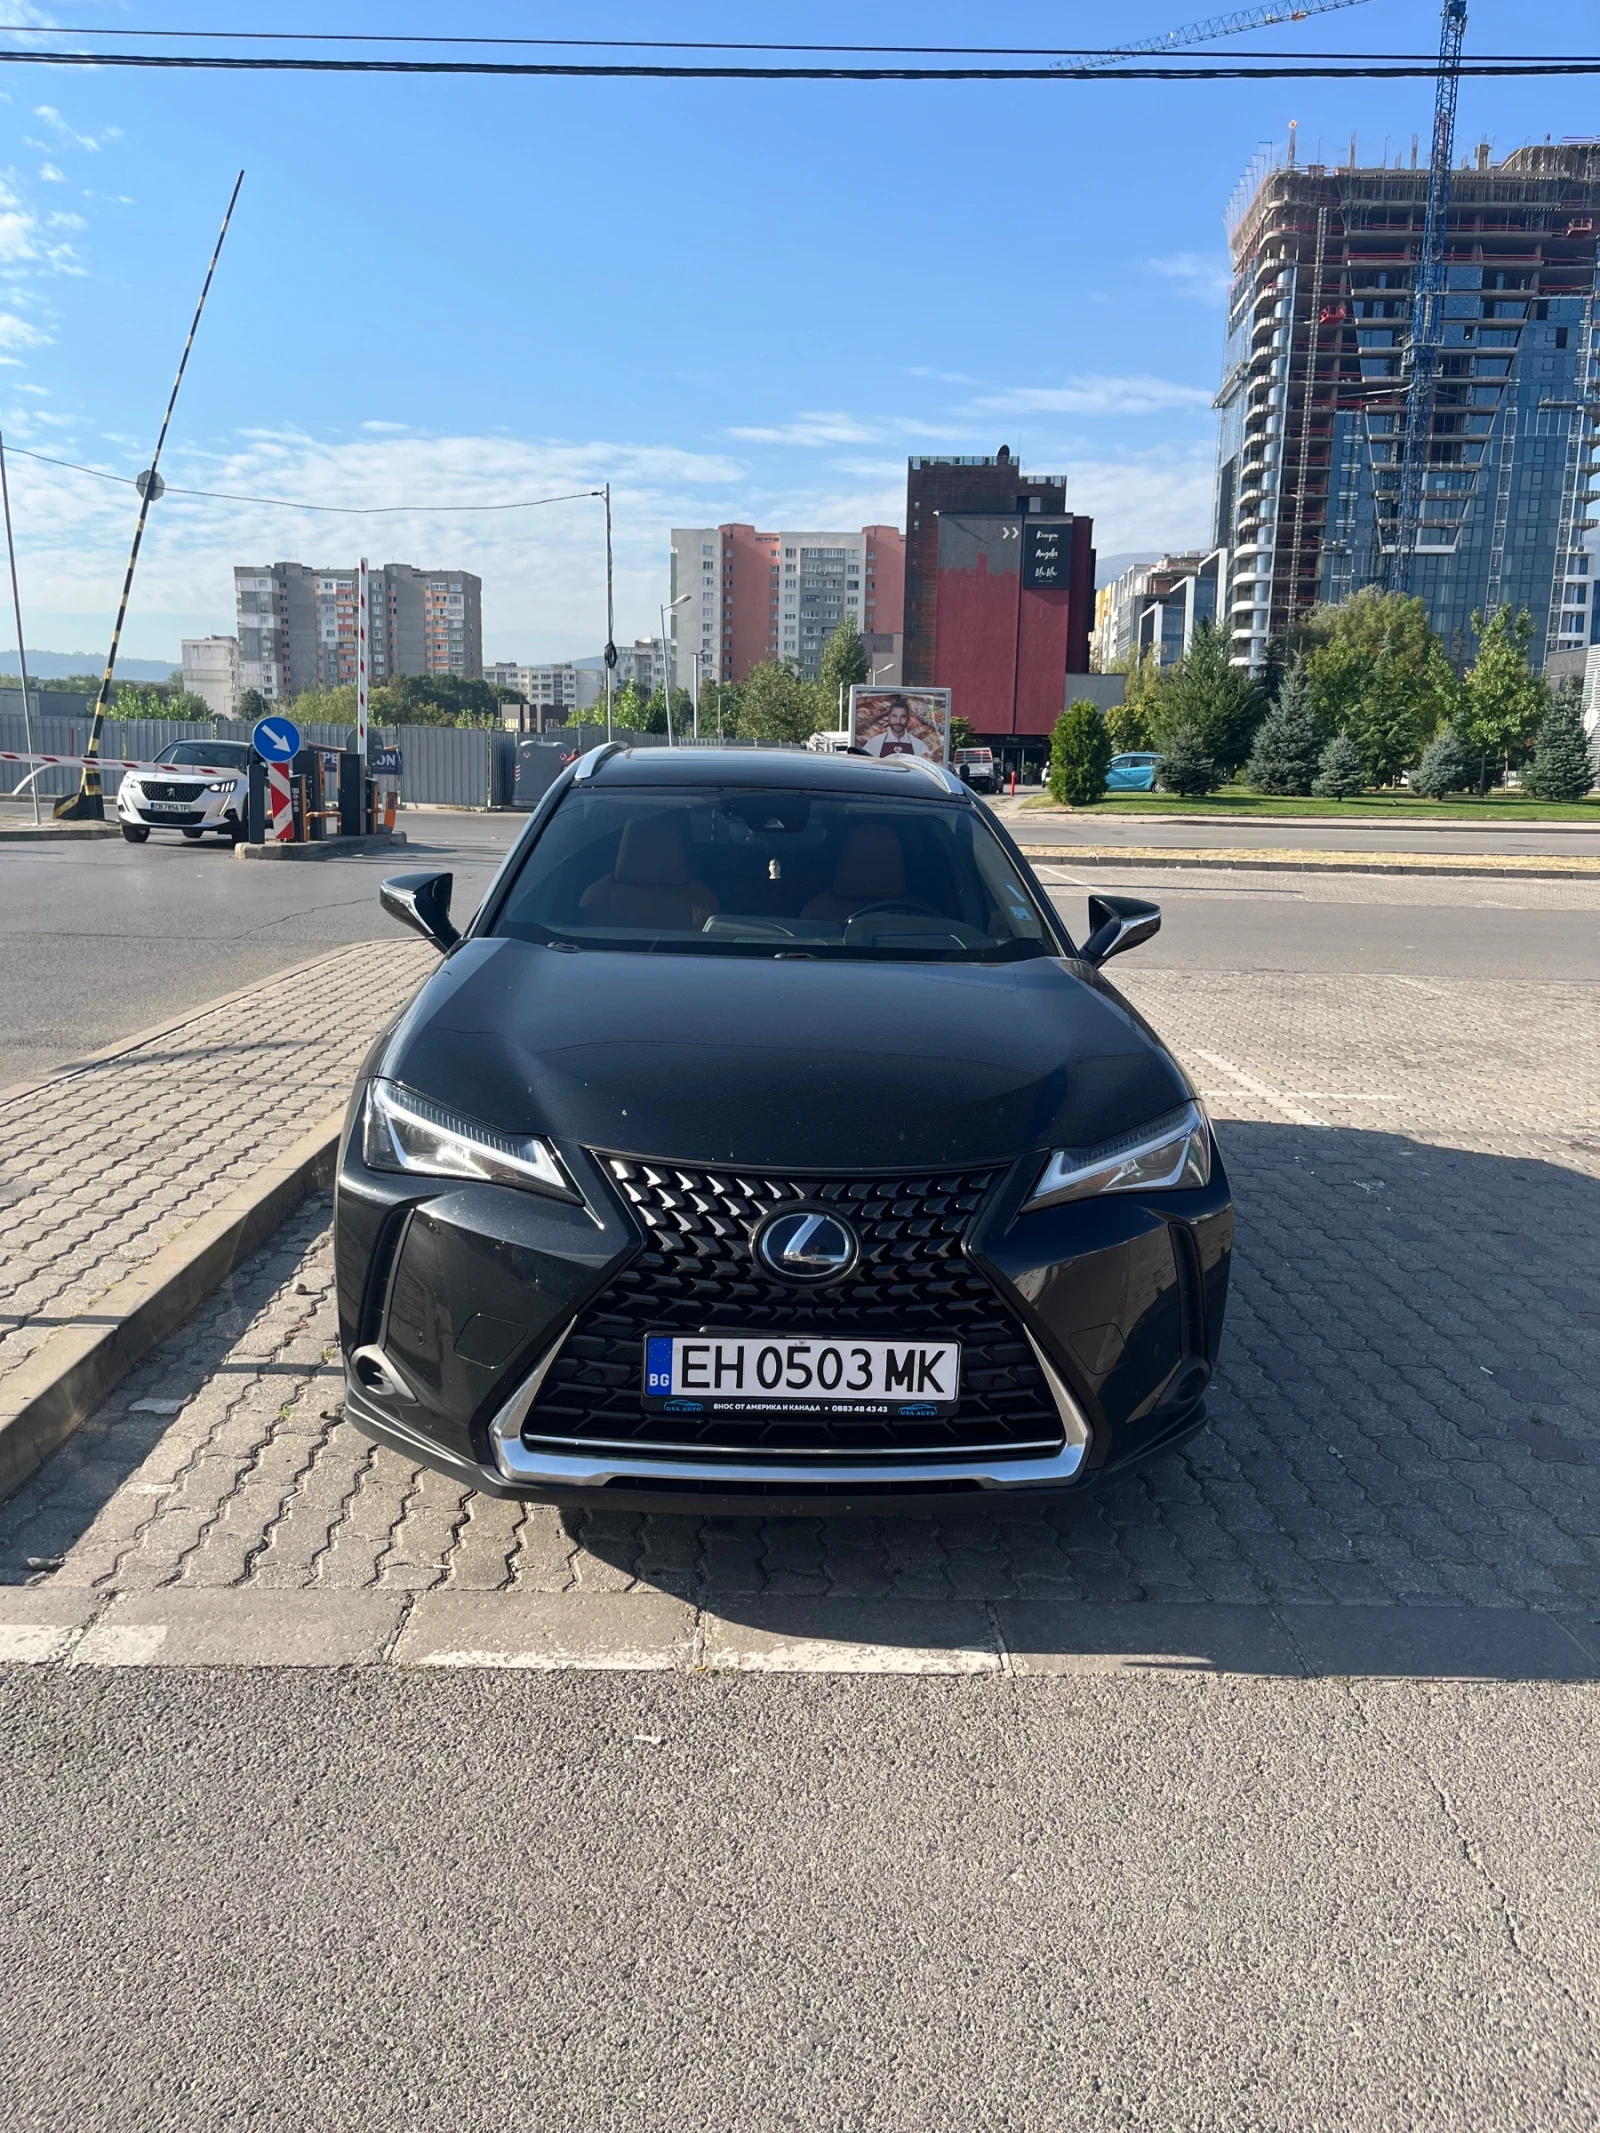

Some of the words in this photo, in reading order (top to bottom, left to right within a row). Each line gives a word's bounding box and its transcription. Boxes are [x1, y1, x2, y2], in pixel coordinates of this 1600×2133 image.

[681, 1345, 745, 1389] EH
[756, 1346, 873, 1391] 0503
[884, 1348, 947, 1393] MK
[649, 1373, 670, 1387] BG
[789, 1404, 820, 1412] КАНАДА
